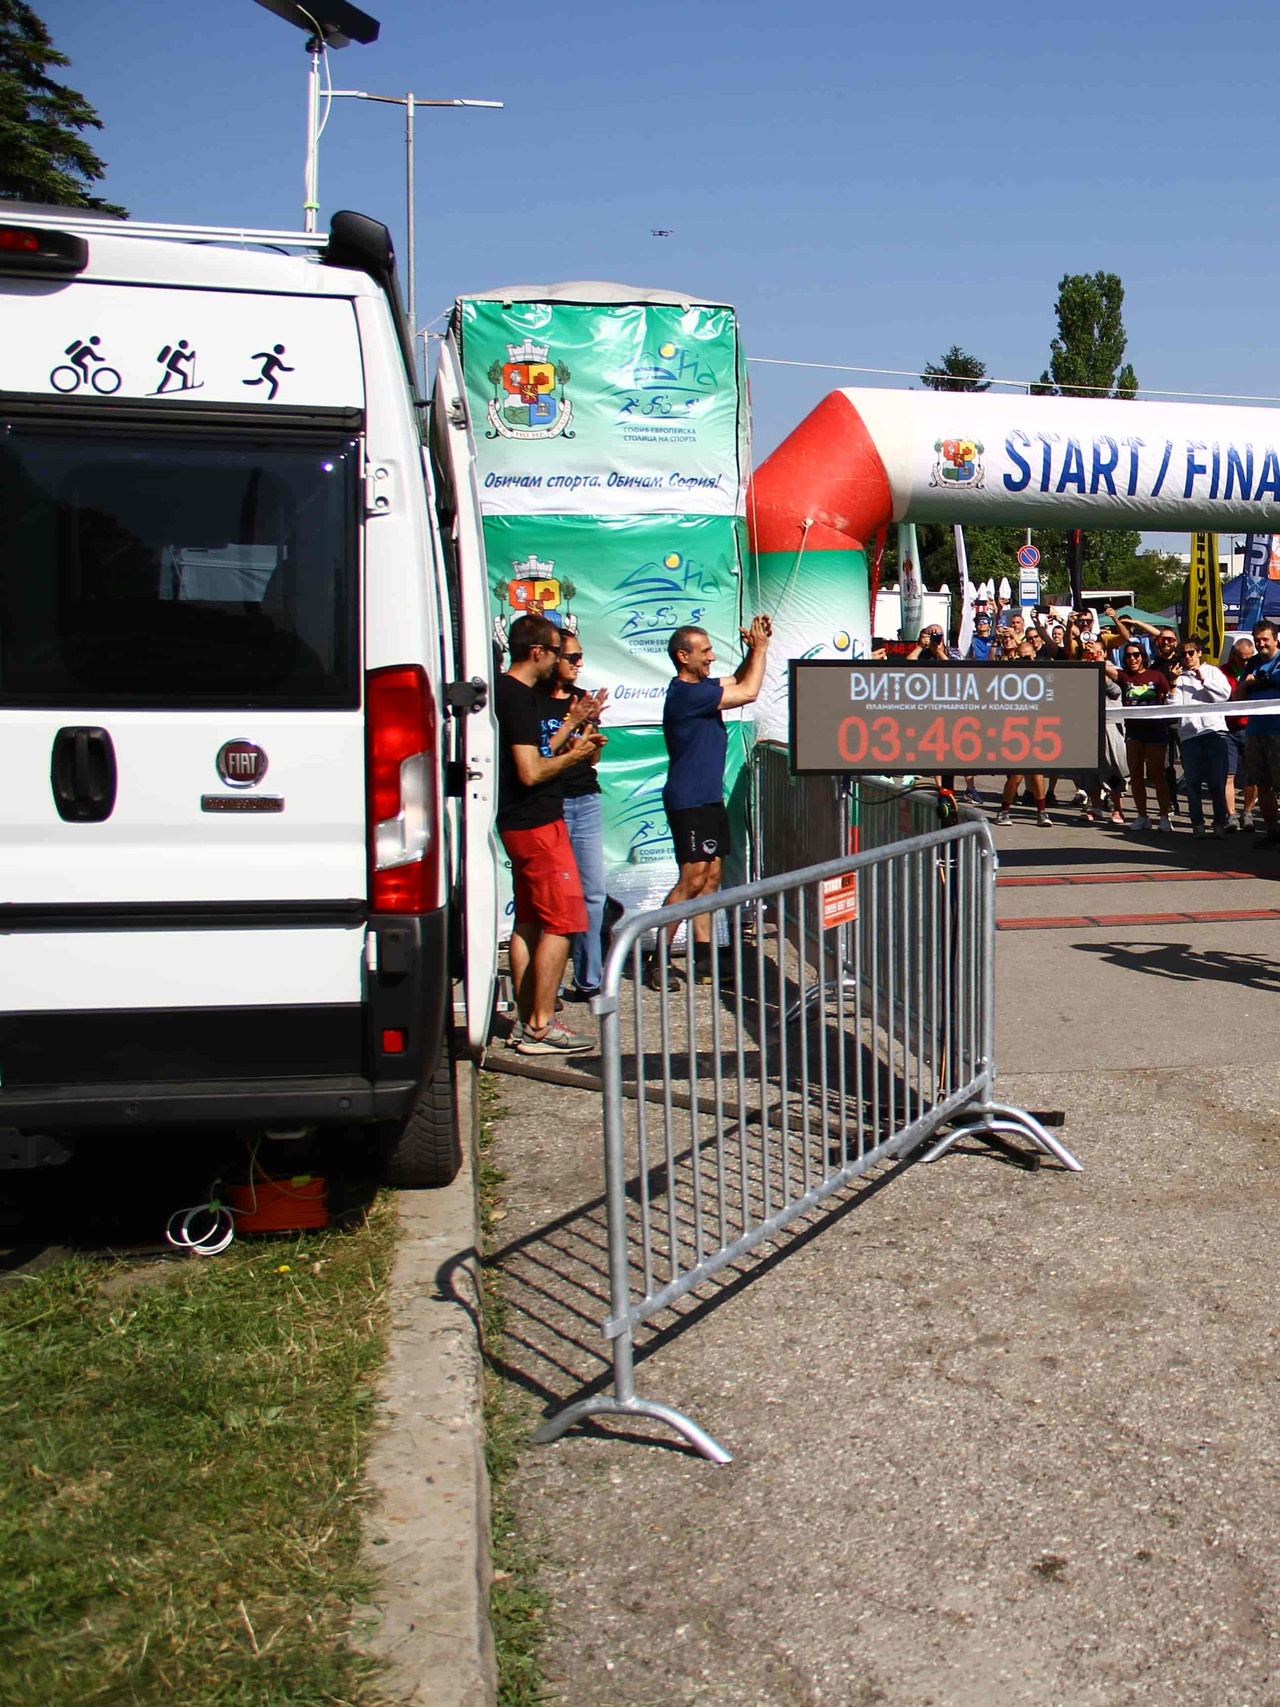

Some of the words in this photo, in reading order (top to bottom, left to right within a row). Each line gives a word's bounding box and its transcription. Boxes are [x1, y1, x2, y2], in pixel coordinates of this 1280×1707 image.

[624, 427, 697, 435] СОФИЯ-ЕВРОПЕЙСКА
[1003, 428, 1146, 497] START
[484, 472, 542, 488] Обичам
[547, 474, 601, 494] спорта.
[668, 472, 722, 491] София!
[851, 672, 980, 700] ВИТОША
[986, 673, 1045, 701] 100
[866, 703, 917, 711] ПЛАНИНСКИ
[917, 703, 980, 711] СУПЕРМАРАТОН
[838, 715, 1062, 762] 03:46:55
[229, 753, 257, 774] FIAT
